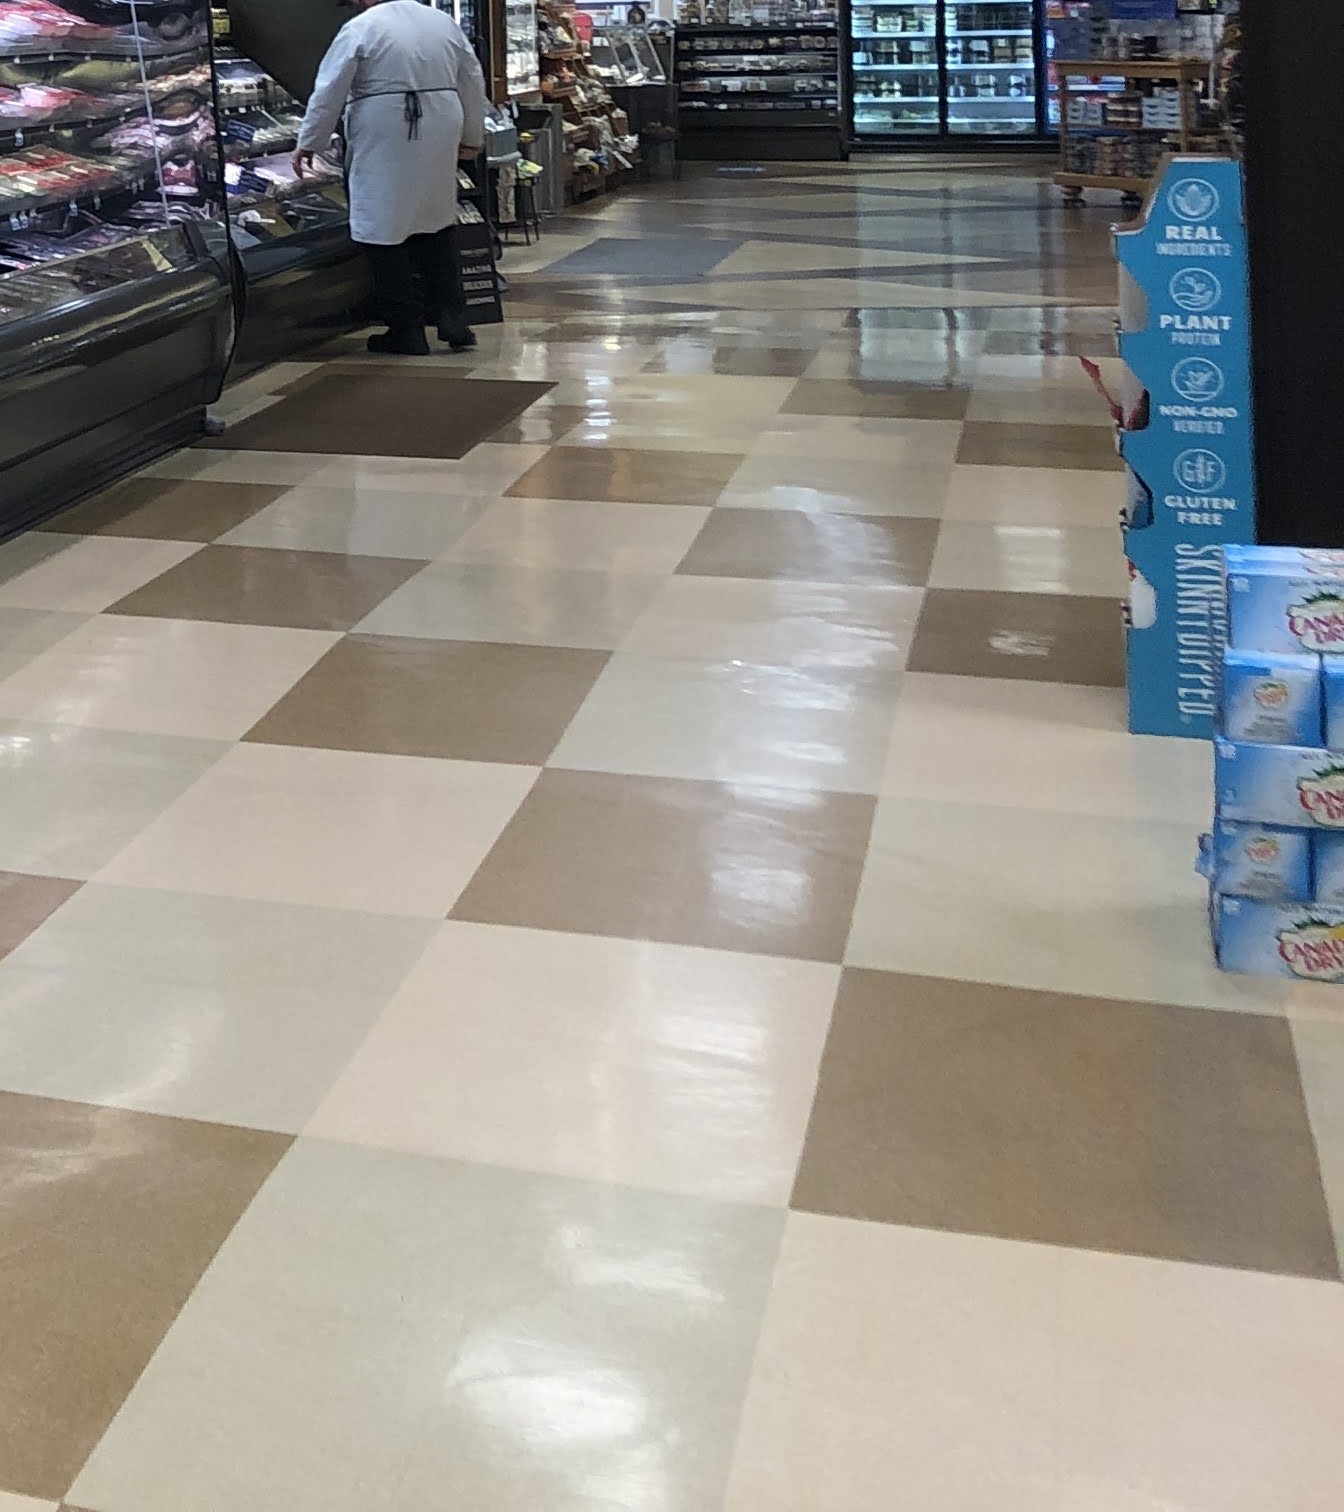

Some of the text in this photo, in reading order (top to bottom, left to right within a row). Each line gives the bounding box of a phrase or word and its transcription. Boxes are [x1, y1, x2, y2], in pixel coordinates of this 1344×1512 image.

[1165, 225, 1223, 241] REAL
[1160, 314, 1232, 330] PLANT
[1164, 495, 1236, 510] GLUTEN
[1177, 511, 1223, 526] FREE
